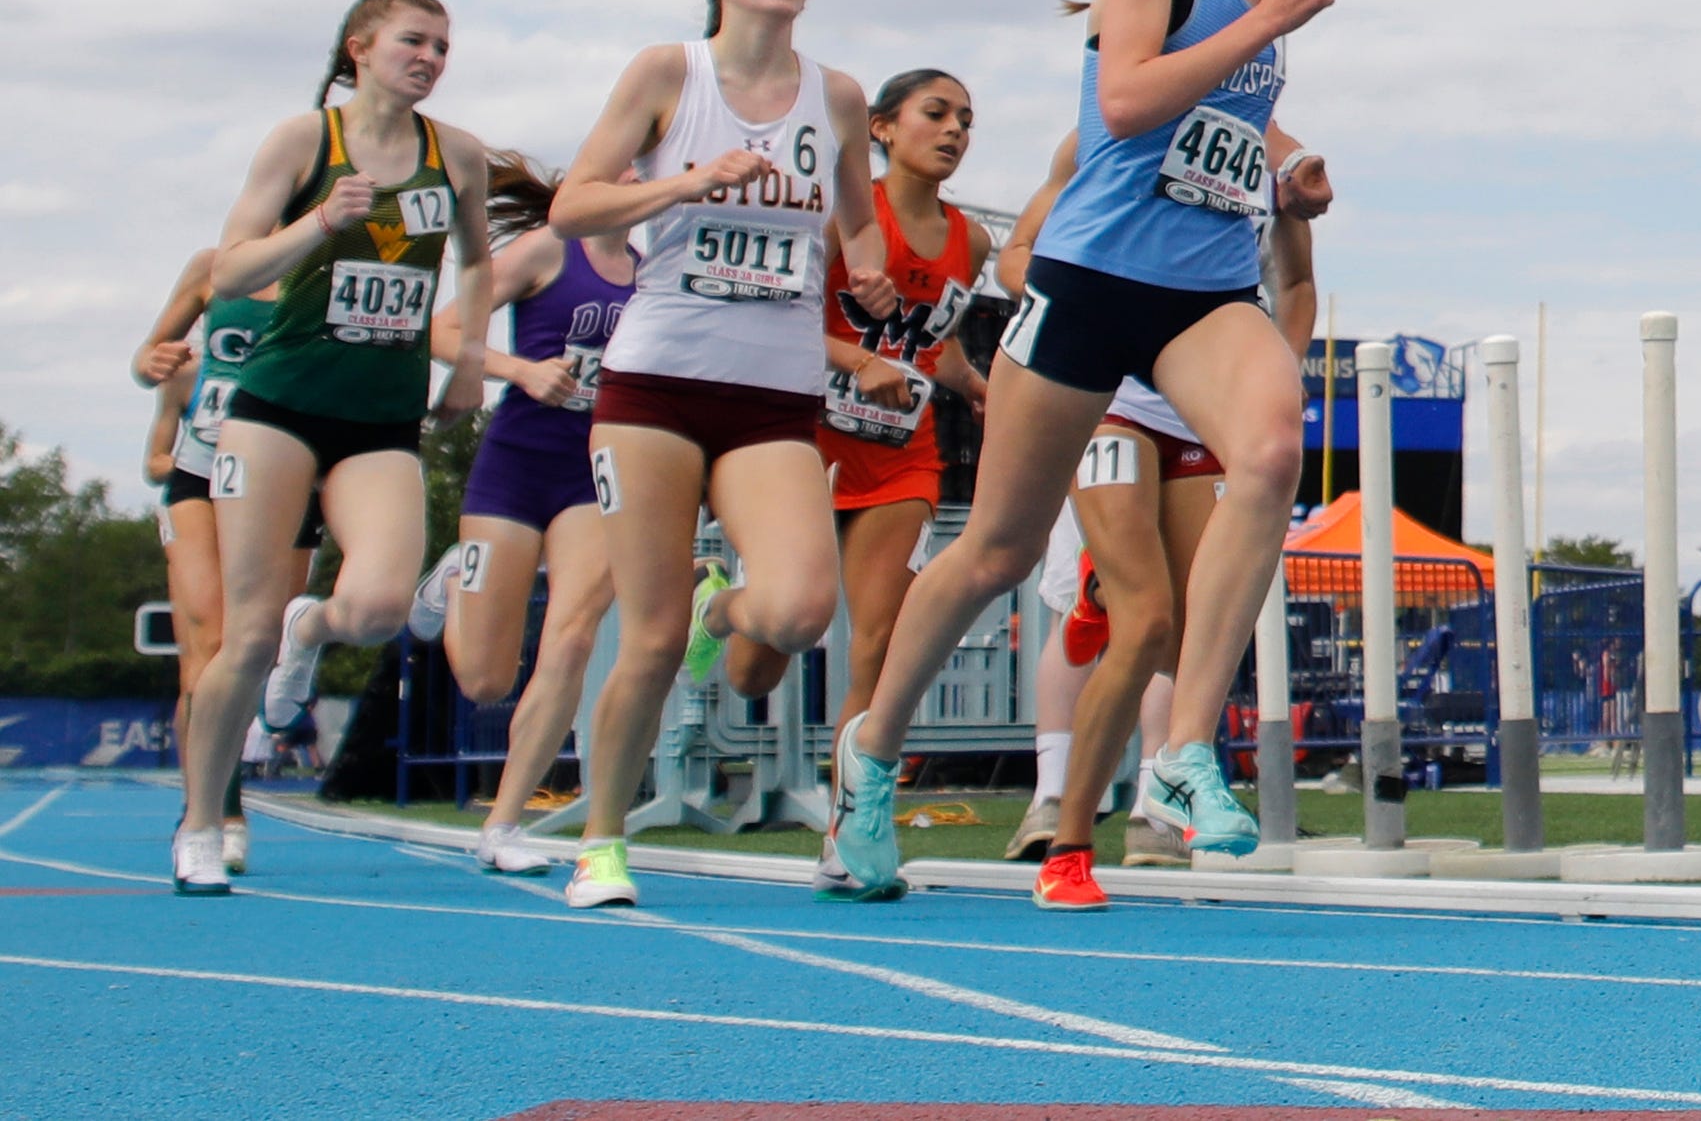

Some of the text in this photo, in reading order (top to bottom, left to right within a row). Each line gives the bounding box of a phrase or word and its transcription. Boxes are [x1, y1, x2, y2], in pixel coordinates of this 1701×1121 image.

[793, 125, 817, 177] 6
[1175, 119, 1265, 193] 4646
[1184, 170, 1215, 189] CLASS
[409, 190, 445, 229] 12
[1206, 192, 1231, 213] TRACK
[694, 227, 795, 276] 5011
[335, 275, 425, 316] 4034
[706, 264, 738, 279] CLASS
[754, 272, 783, 287] GIRLS
[733, 282, 760, 298] TRACK
[931, 286, 965, 333] 5
[838, 401, 866, 418] CLASS
[214, 454, 237, 495] 12
[595, 453, 611, 511] 6
[1085, 440, 1119, 484] 11
[463, 544, 480, 588] 9
